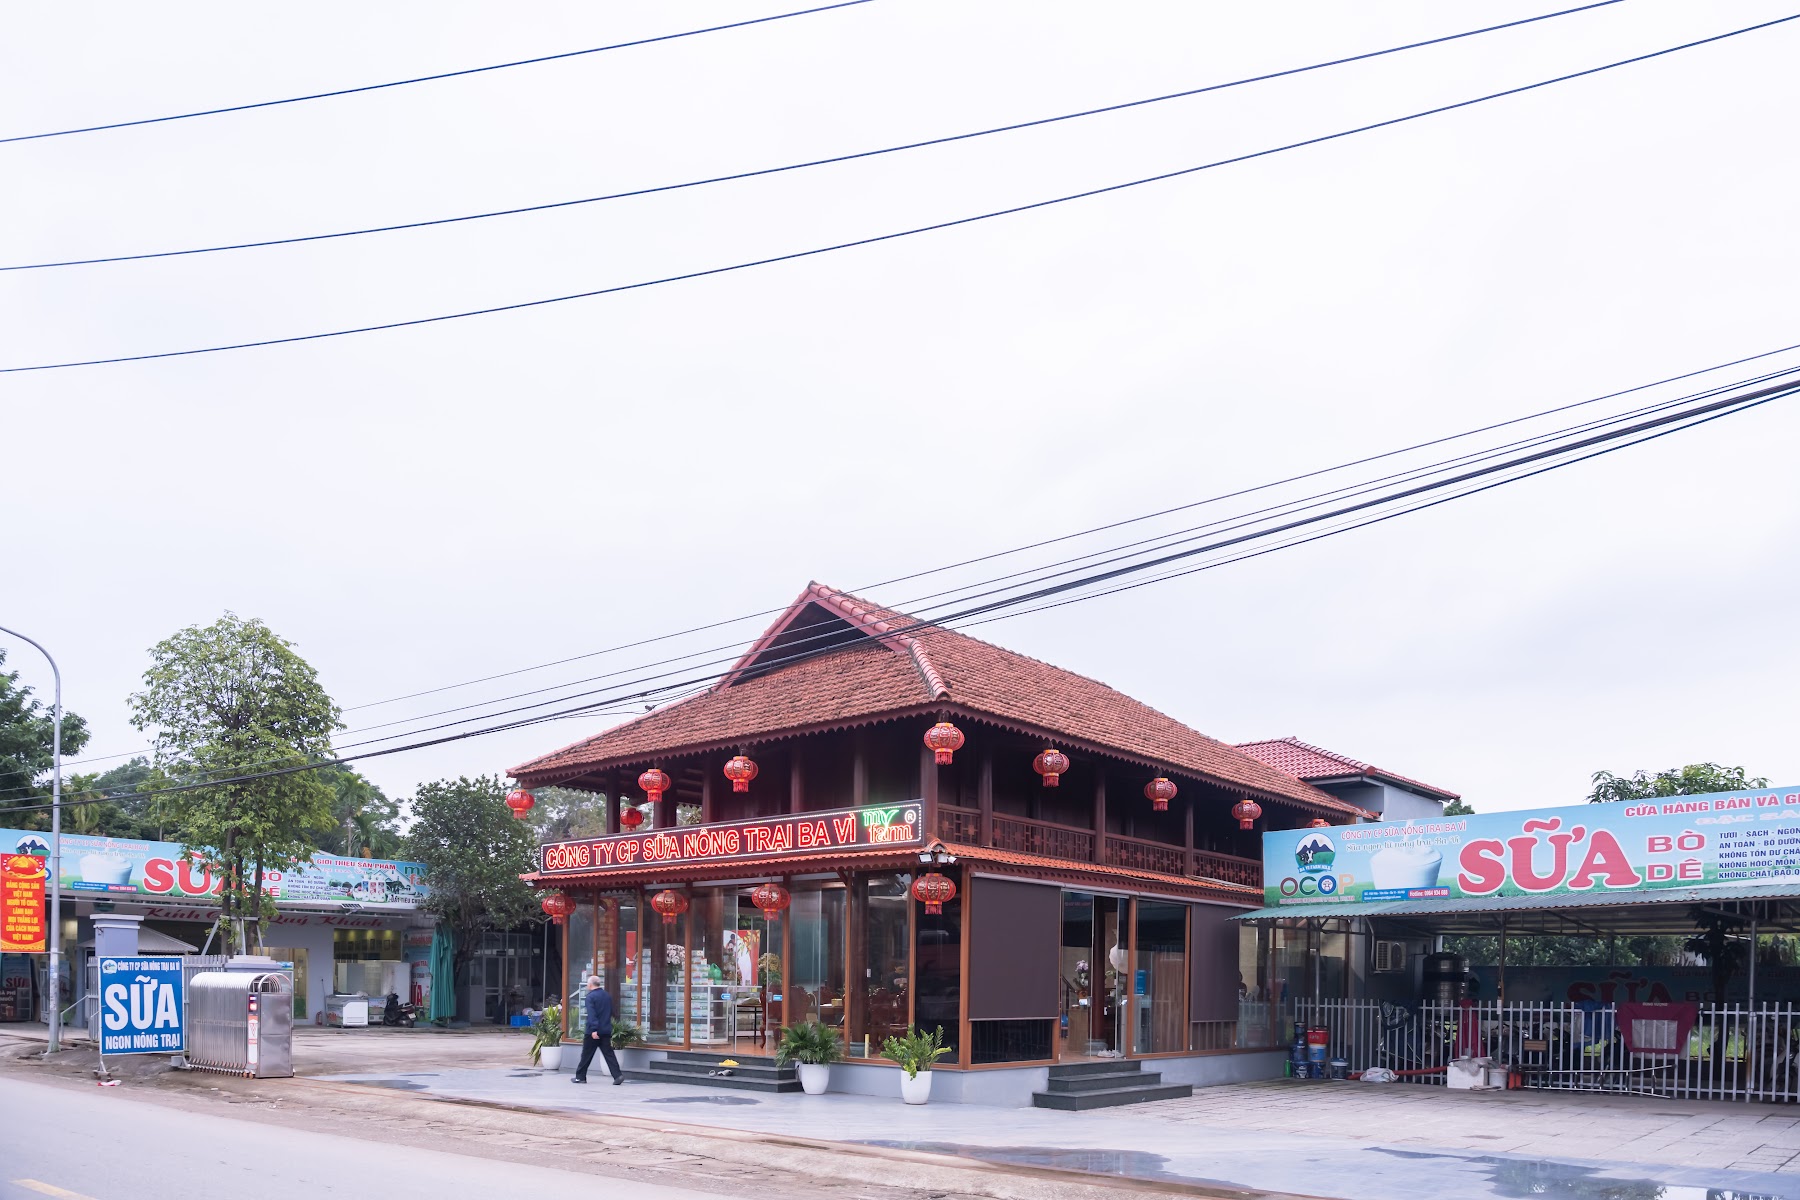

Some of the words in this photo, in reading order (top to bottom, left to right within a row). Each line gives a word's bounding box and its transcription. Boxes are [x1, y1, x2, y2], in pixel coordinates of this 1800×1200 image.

[1626, 804, 1657, 816] CỬA
[1663, 802, 1708, 814] HÀNG
[1715, 798, 1750, 810] BÁN
[1757, 794, 1779, 806] VÀ
[868, 824, 913, 843] farm
[1342, 829, 1362, 840] CÔNG
[1363, 830, 1372, 838] TY
[1374, 829, 1382, 838] CP
[1385, 826, 1399, 837] SỮA
[1401, 824, 1424, 835] NÔNG
[1445, 822, 1456, 832] BA
[1458, 820, 1466, 831] VÌ
[1746, 830, 1769, 839] SẠCH
[546, 844, 589, 869] CÔNG
[593, 842, 615, 865] TY
[617, 840, 639, 863] CP
[643, 833, 681, 861] SỮA
[684, 828, 739, 857] NÔNG
[744, 824, 792, 852] TRẠI
[798, 820, 831, 847] BA
[834, 812, 856, 844] VÌ
[1648, 830, 1705, 853] BÒ
[1458, 818, 1641, 893] SỮA
[1719, 850, 1748, 859] KHÔNG
[1648, 858, 1702, 881] DÊ
[1718, 870, 1747, 878] KHÔNG
[1719, 860, 1747, 869] KHÔNG
[1280, 874, 1354, 896] OCOP
[267, 914, 310, 926] Quý
[320, 915, 384, 927] Khách
[118, 960, 128, 971] CÔNG
[129, 962, 134, 971] TY
[105, 975, 179, 1030] SỮA
[106, 1035, 131, 1049] NGON
[134, 1032, 158, 1048] NÔNG
[161, 1033, 180, 1048] TRẠI
